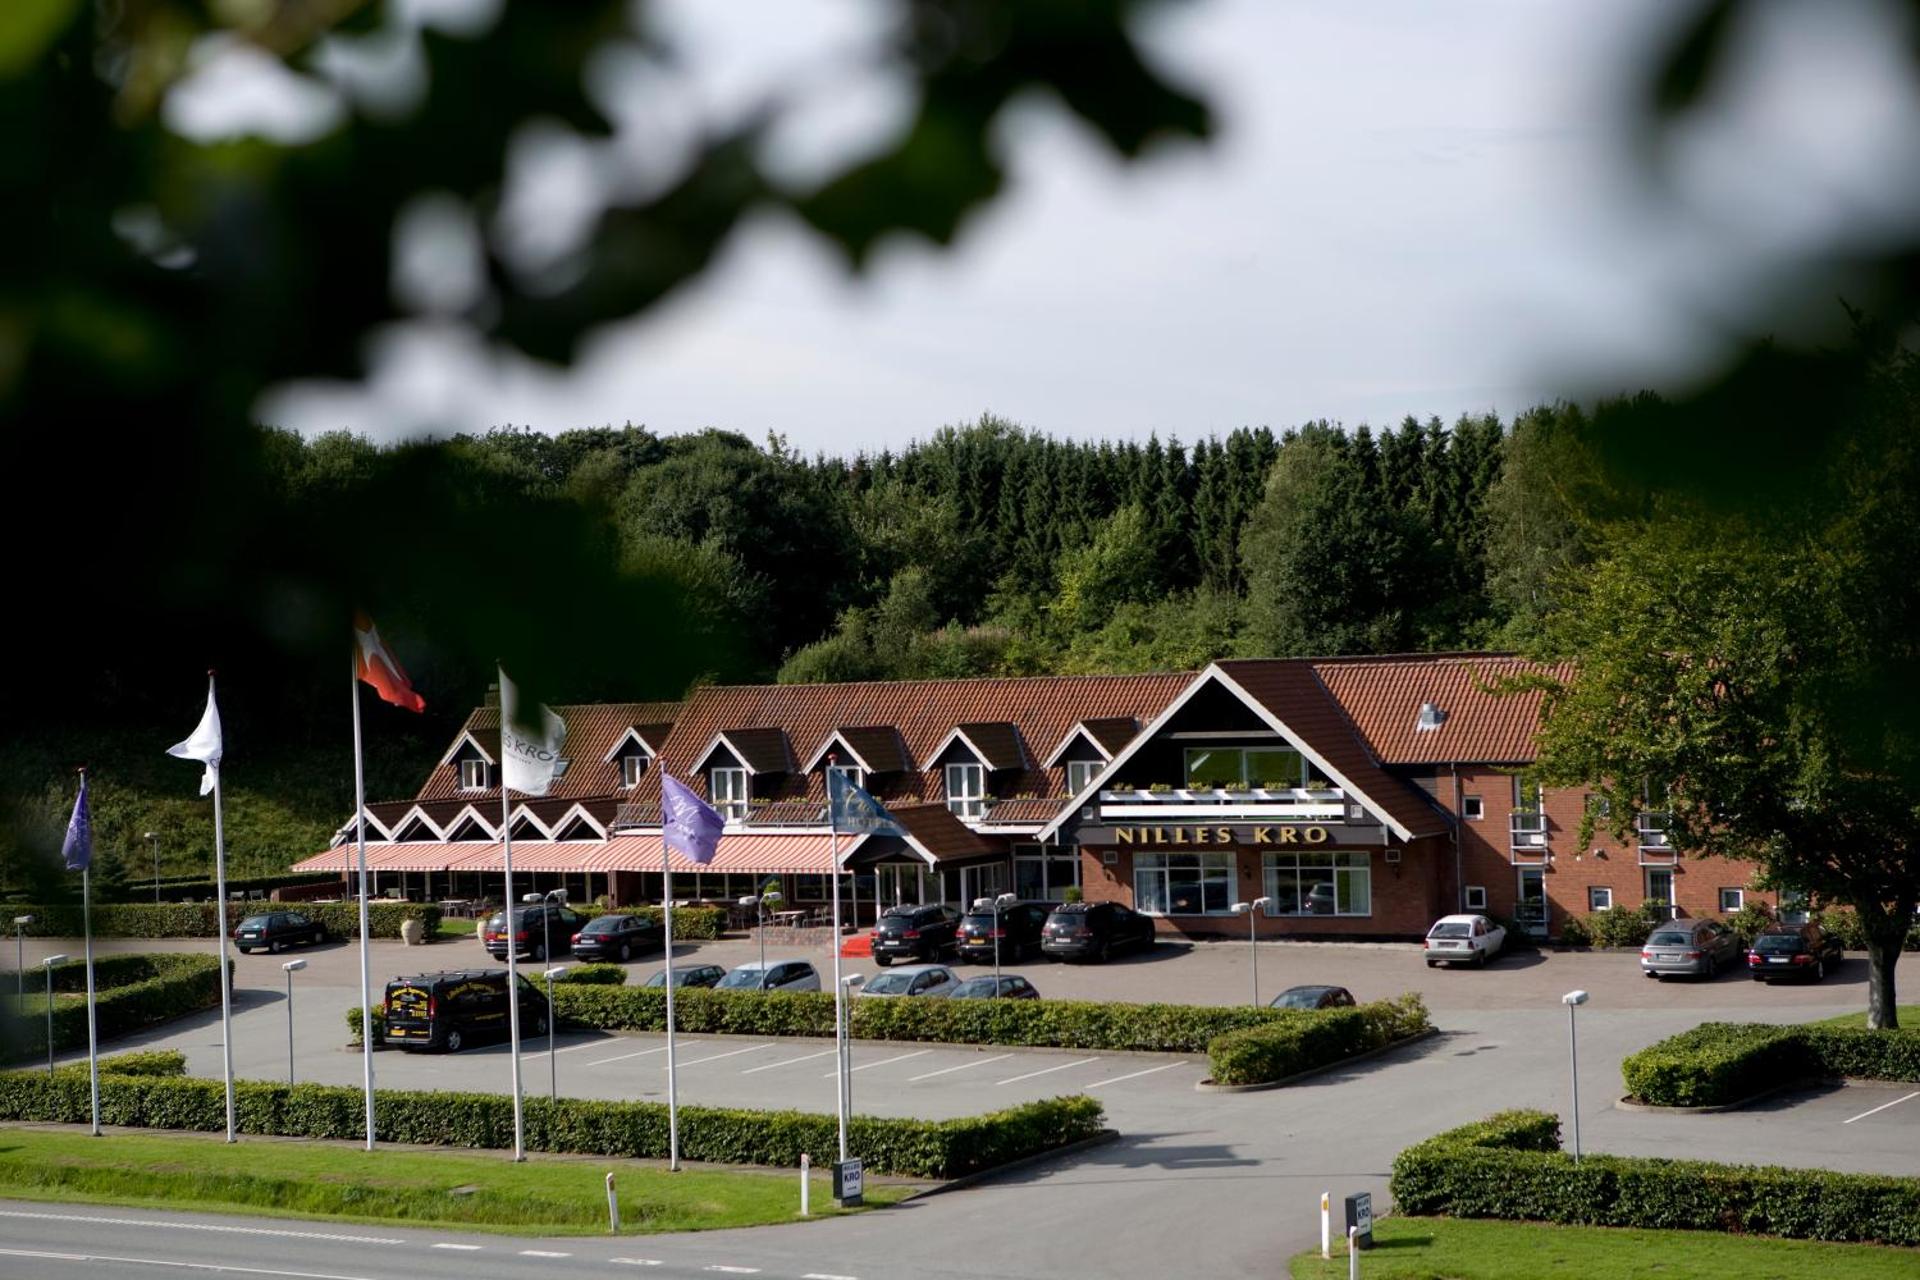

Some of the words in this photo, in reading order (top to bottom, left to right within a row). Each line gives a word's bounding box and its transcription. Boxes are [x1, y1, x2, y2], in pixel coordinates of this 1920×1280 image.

[1115, 827, 1231, 844] NILLES
[1254, 826, 1328, 844] KRO
[844, 1171, 860, 1183] KRO
